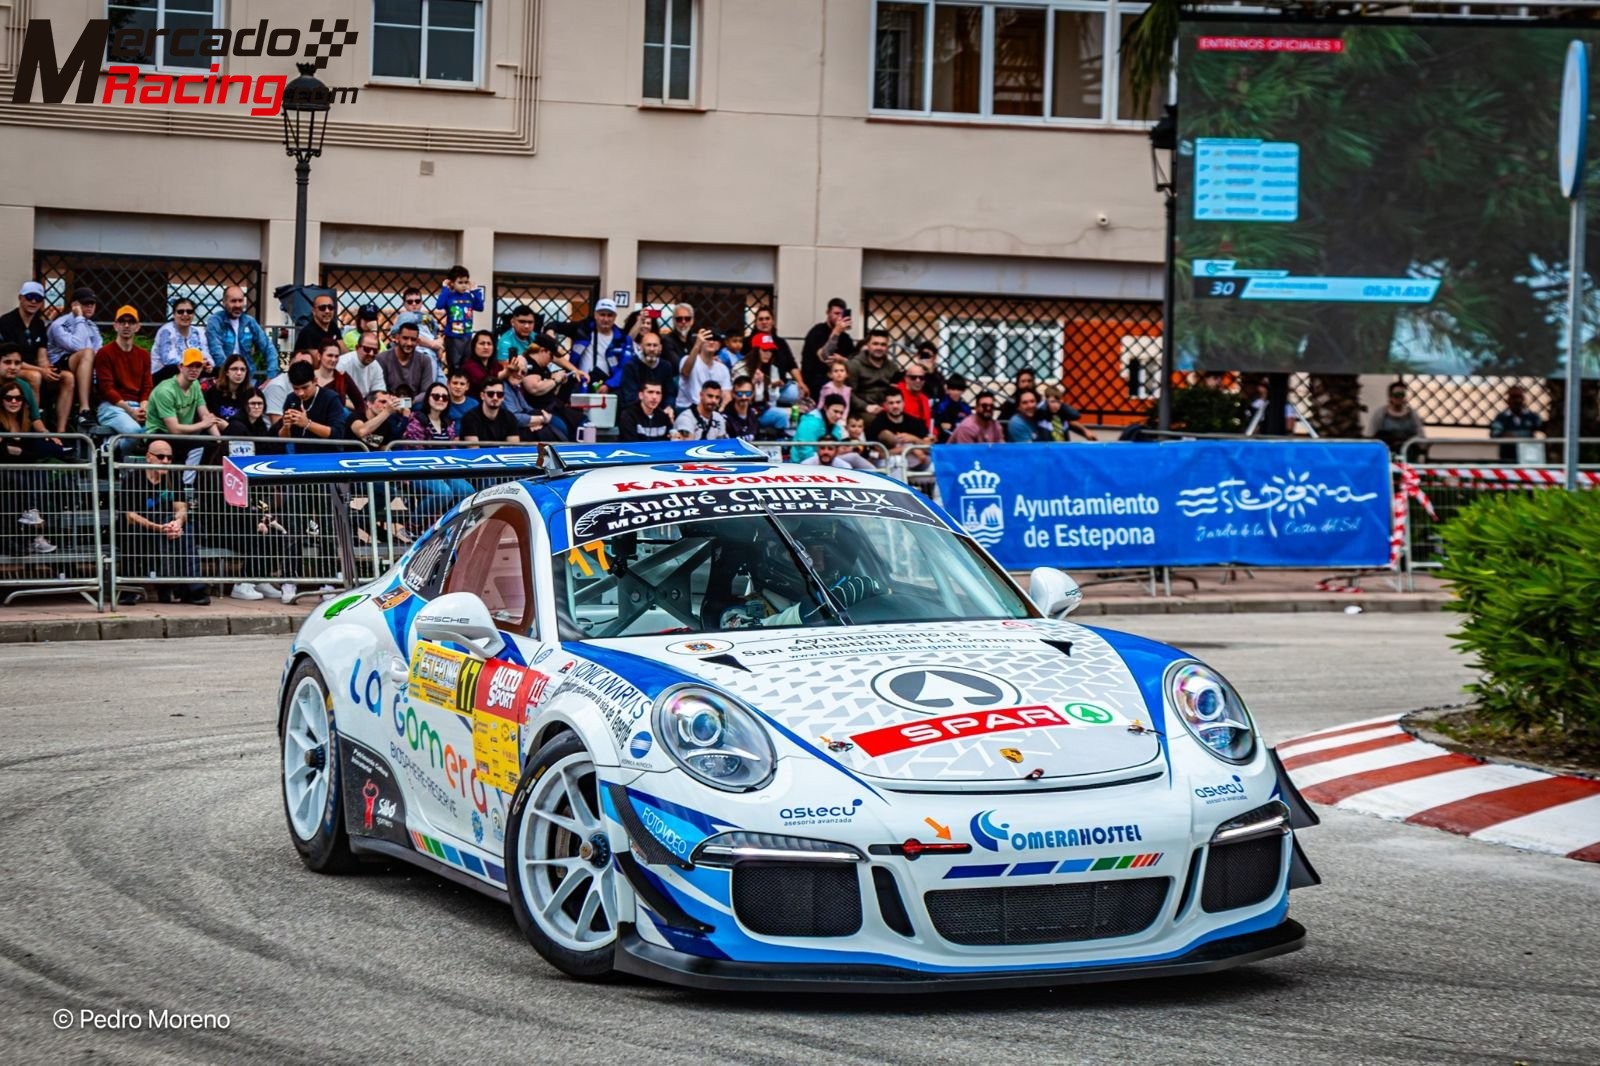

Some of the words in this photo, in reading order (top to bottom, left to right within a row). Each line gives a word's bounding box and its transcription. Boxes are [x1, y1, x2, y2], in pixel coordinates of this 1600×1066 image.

[1200, 38, 1265, 50] ENTRENOS
[1267, 39, 1331, 51] OFICIALES
[616, 293, 627, 305] 77
[1210, 281, 1236, 296] 30
[613, 474, 860, 493] KALIGOMERA
[620, 490, 716, 516] André
[728, 488, 894, 507] CHIPEAUX
[1013, 493, 1159, 522] Ayuntamiento
[607, 508, 700, 530] MOTOR
[714, 502, 831, 514] CONCEPT
[1024, 526, 1051, 549] de
[1055, 524, 1155, 550] Estepona
[568, 540, 610, 576] 17
[742, 648, 782, 657] San
[788, 640, 891, 652] Sebastián
[898, 637, 922, 645] de
[795, 630, 940, 645] Ayuntamiento
[461, 659, 482, 711] 17
[490, 666, 524, 692] AUTO
[487, 685, 516, 709] SPORT
[900, 708, 1061, 742] SPAR
[1195, 779, 1245, 798] astecu
[780, 804, 858, 819] astecu
